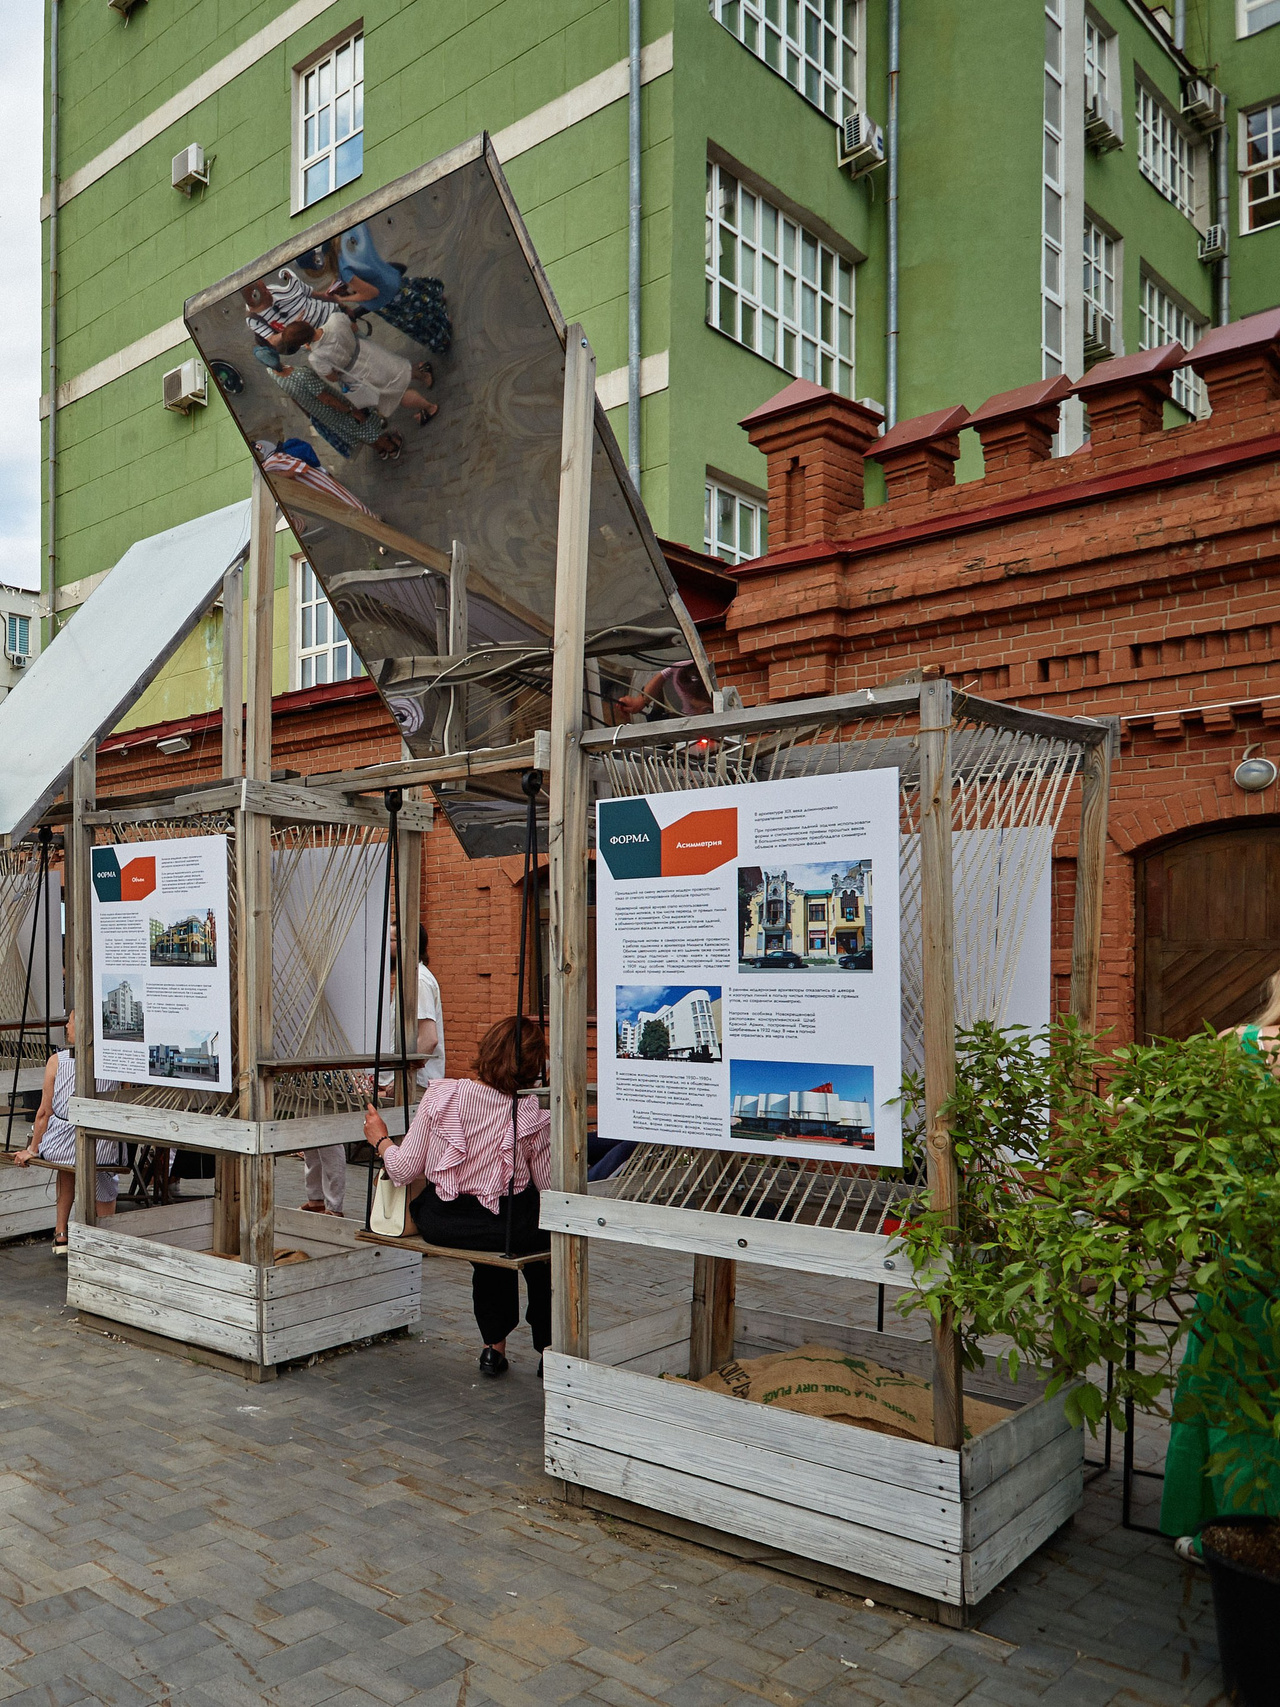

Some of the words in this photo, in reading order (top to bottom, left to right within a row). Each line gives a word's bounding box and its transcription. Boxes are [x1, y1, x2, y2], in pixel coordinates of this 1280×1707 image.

[610, 833, 650, 844] ФОРМА
[676, 840, 722, 849] Асимметрия
[795, 1383, 818, 1394] DRY
[821, 1384, 851, 1396] COOL
[854, 1390, 863, 1398] A
[762, 1385, 791, 1404] PLACE
[865, 1392, 877, 1401] IN
